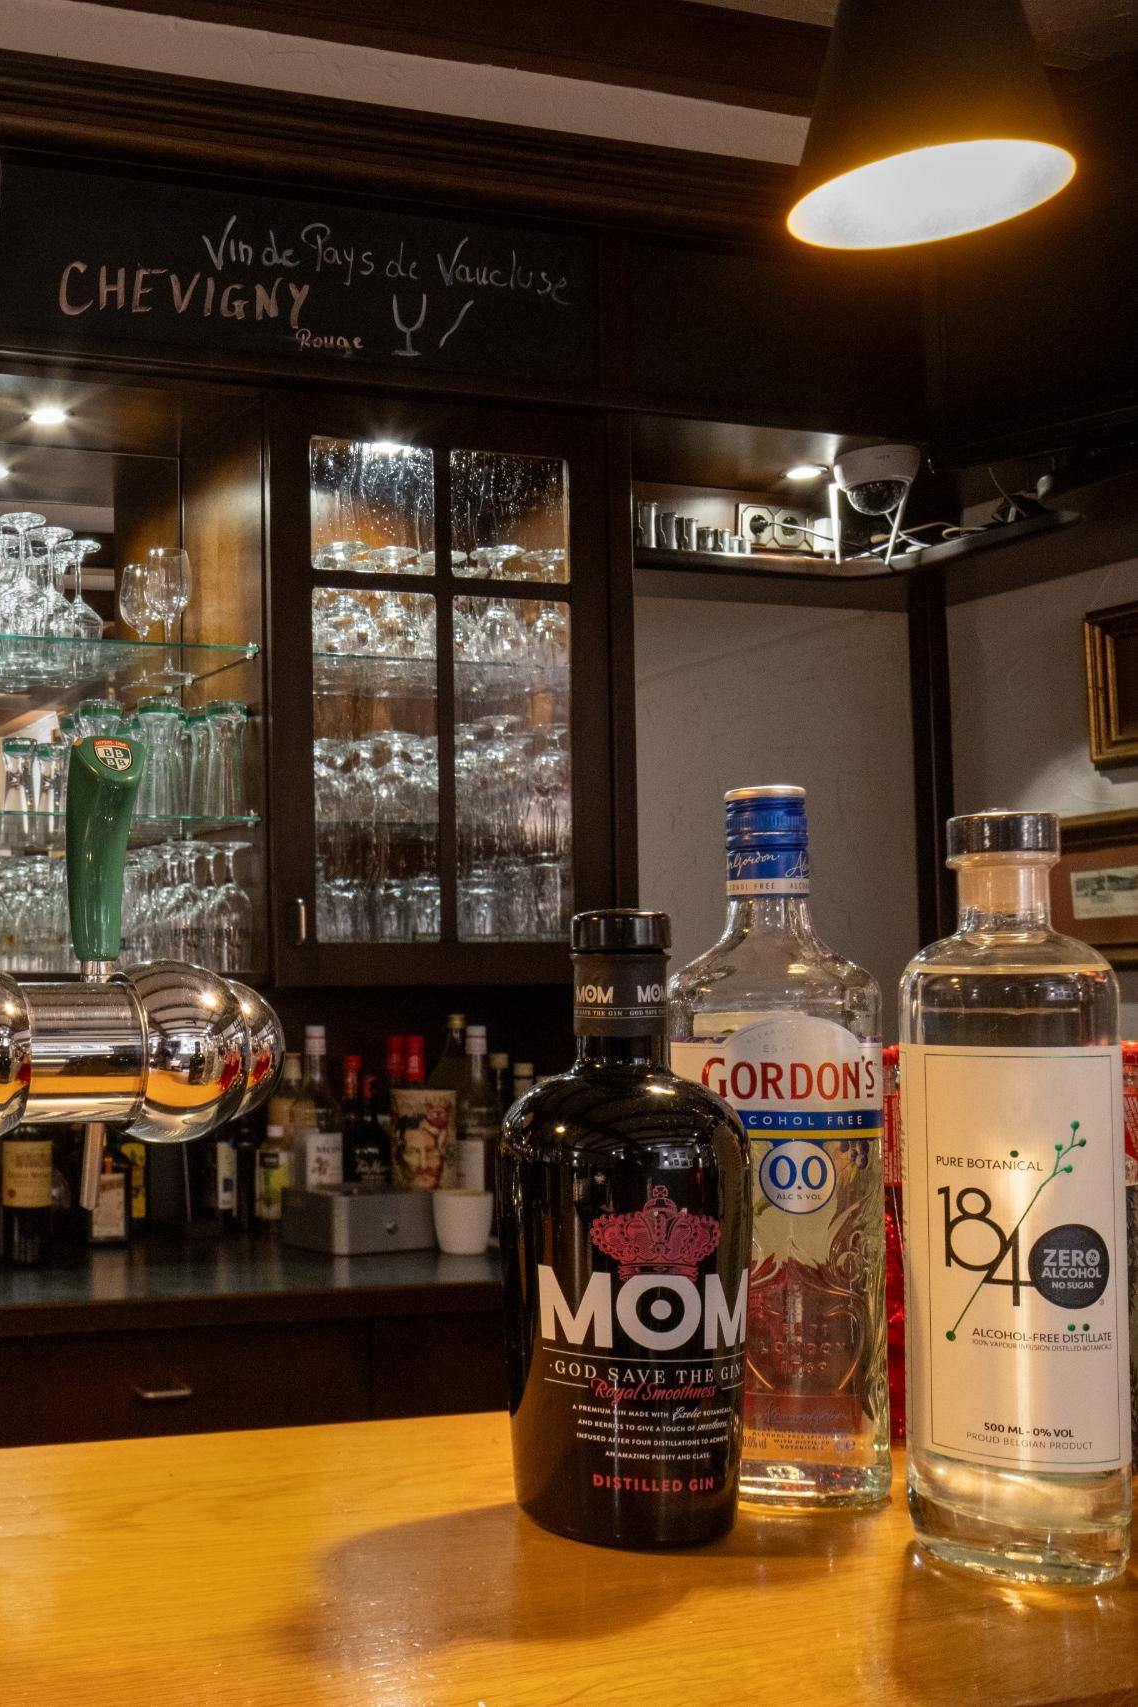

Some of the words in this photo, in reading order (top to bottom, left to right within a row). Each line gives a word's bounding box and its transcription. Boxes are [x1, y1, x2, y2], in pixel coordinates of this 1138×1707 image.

[202, 215, 253, 271] Vin
[261, 229, 300, 268] de
[300, 222, 375, 285] Pays
[385, 242, 420, 281] de
[58, 260, 310, 329] CHEVIGNY
[295, 328, 363, 352] Rouge
[576, 984, 614, 1004] MOM
[608, 1009, 623, 1017] GIN
[701, 1056, 876, 1101] GORDON'S
[748, 1115, 814, 1126] COHOL
[827, 1114, 863, 1125] FREE
[768, 1154, 828, 1190] 0.0
[936, 1155, 964, 1168] PURE
[967, 1157, 1044, 1172] BOTANICAL
[1042, 1248, 1101, 1267] ZERO
[1041, 1267, 1102, 1279] ALCOHOL
[1051, 1281, 1066, 1289] NO
[1067, 1281, 1094, 1289] SUGAR
[538, 1263, 749, 1351] MOM
[972, 1327, 1060, 1343] ALCOHOL-FREE
[1062, 1330, 1112, 1344] DISTILLATE
[554, 1359, 598, 1380] GOD
[608, 1367, 665, 1384] SAVE
[675, 1368, 714, 1384] THE
[720, 1362, 742, 1381] GIN
[591, 1377, 643, 1404] Royal
[642, 1379, 717, 1402] Smoothness
[578, 1405, 611, 1415] PREMIUM
[628, 1410, 649, 1418] MADE
[577, 1418, 593, 1426] AND
[687, 1424, 696, 1432] OF
[984, 1422, 1005, 1433] 500
[1007, 1425, 1024, 1435] ML
[1032, 1428, 1052, 1438] 0%
[1053, 1428, 1074, 1438] VOL
[576, 1432, 606, 1442] INFUSED
[631, 1438, 652, 1446] FOUR
[653, 1439, 700, 1447] DISTILLATIONS
[966, 1431, 1000, 1445] PROUD
[1003, 1437, 1046, 1449] BELGIAN
[1049, 1441, 1093, 1450] PRODUCT
[617, 1451, 650, 1460] AMAZING
[592, 1473, 684, 1493] DISTILLED
[688, 1477, 714, 1492] GIN
